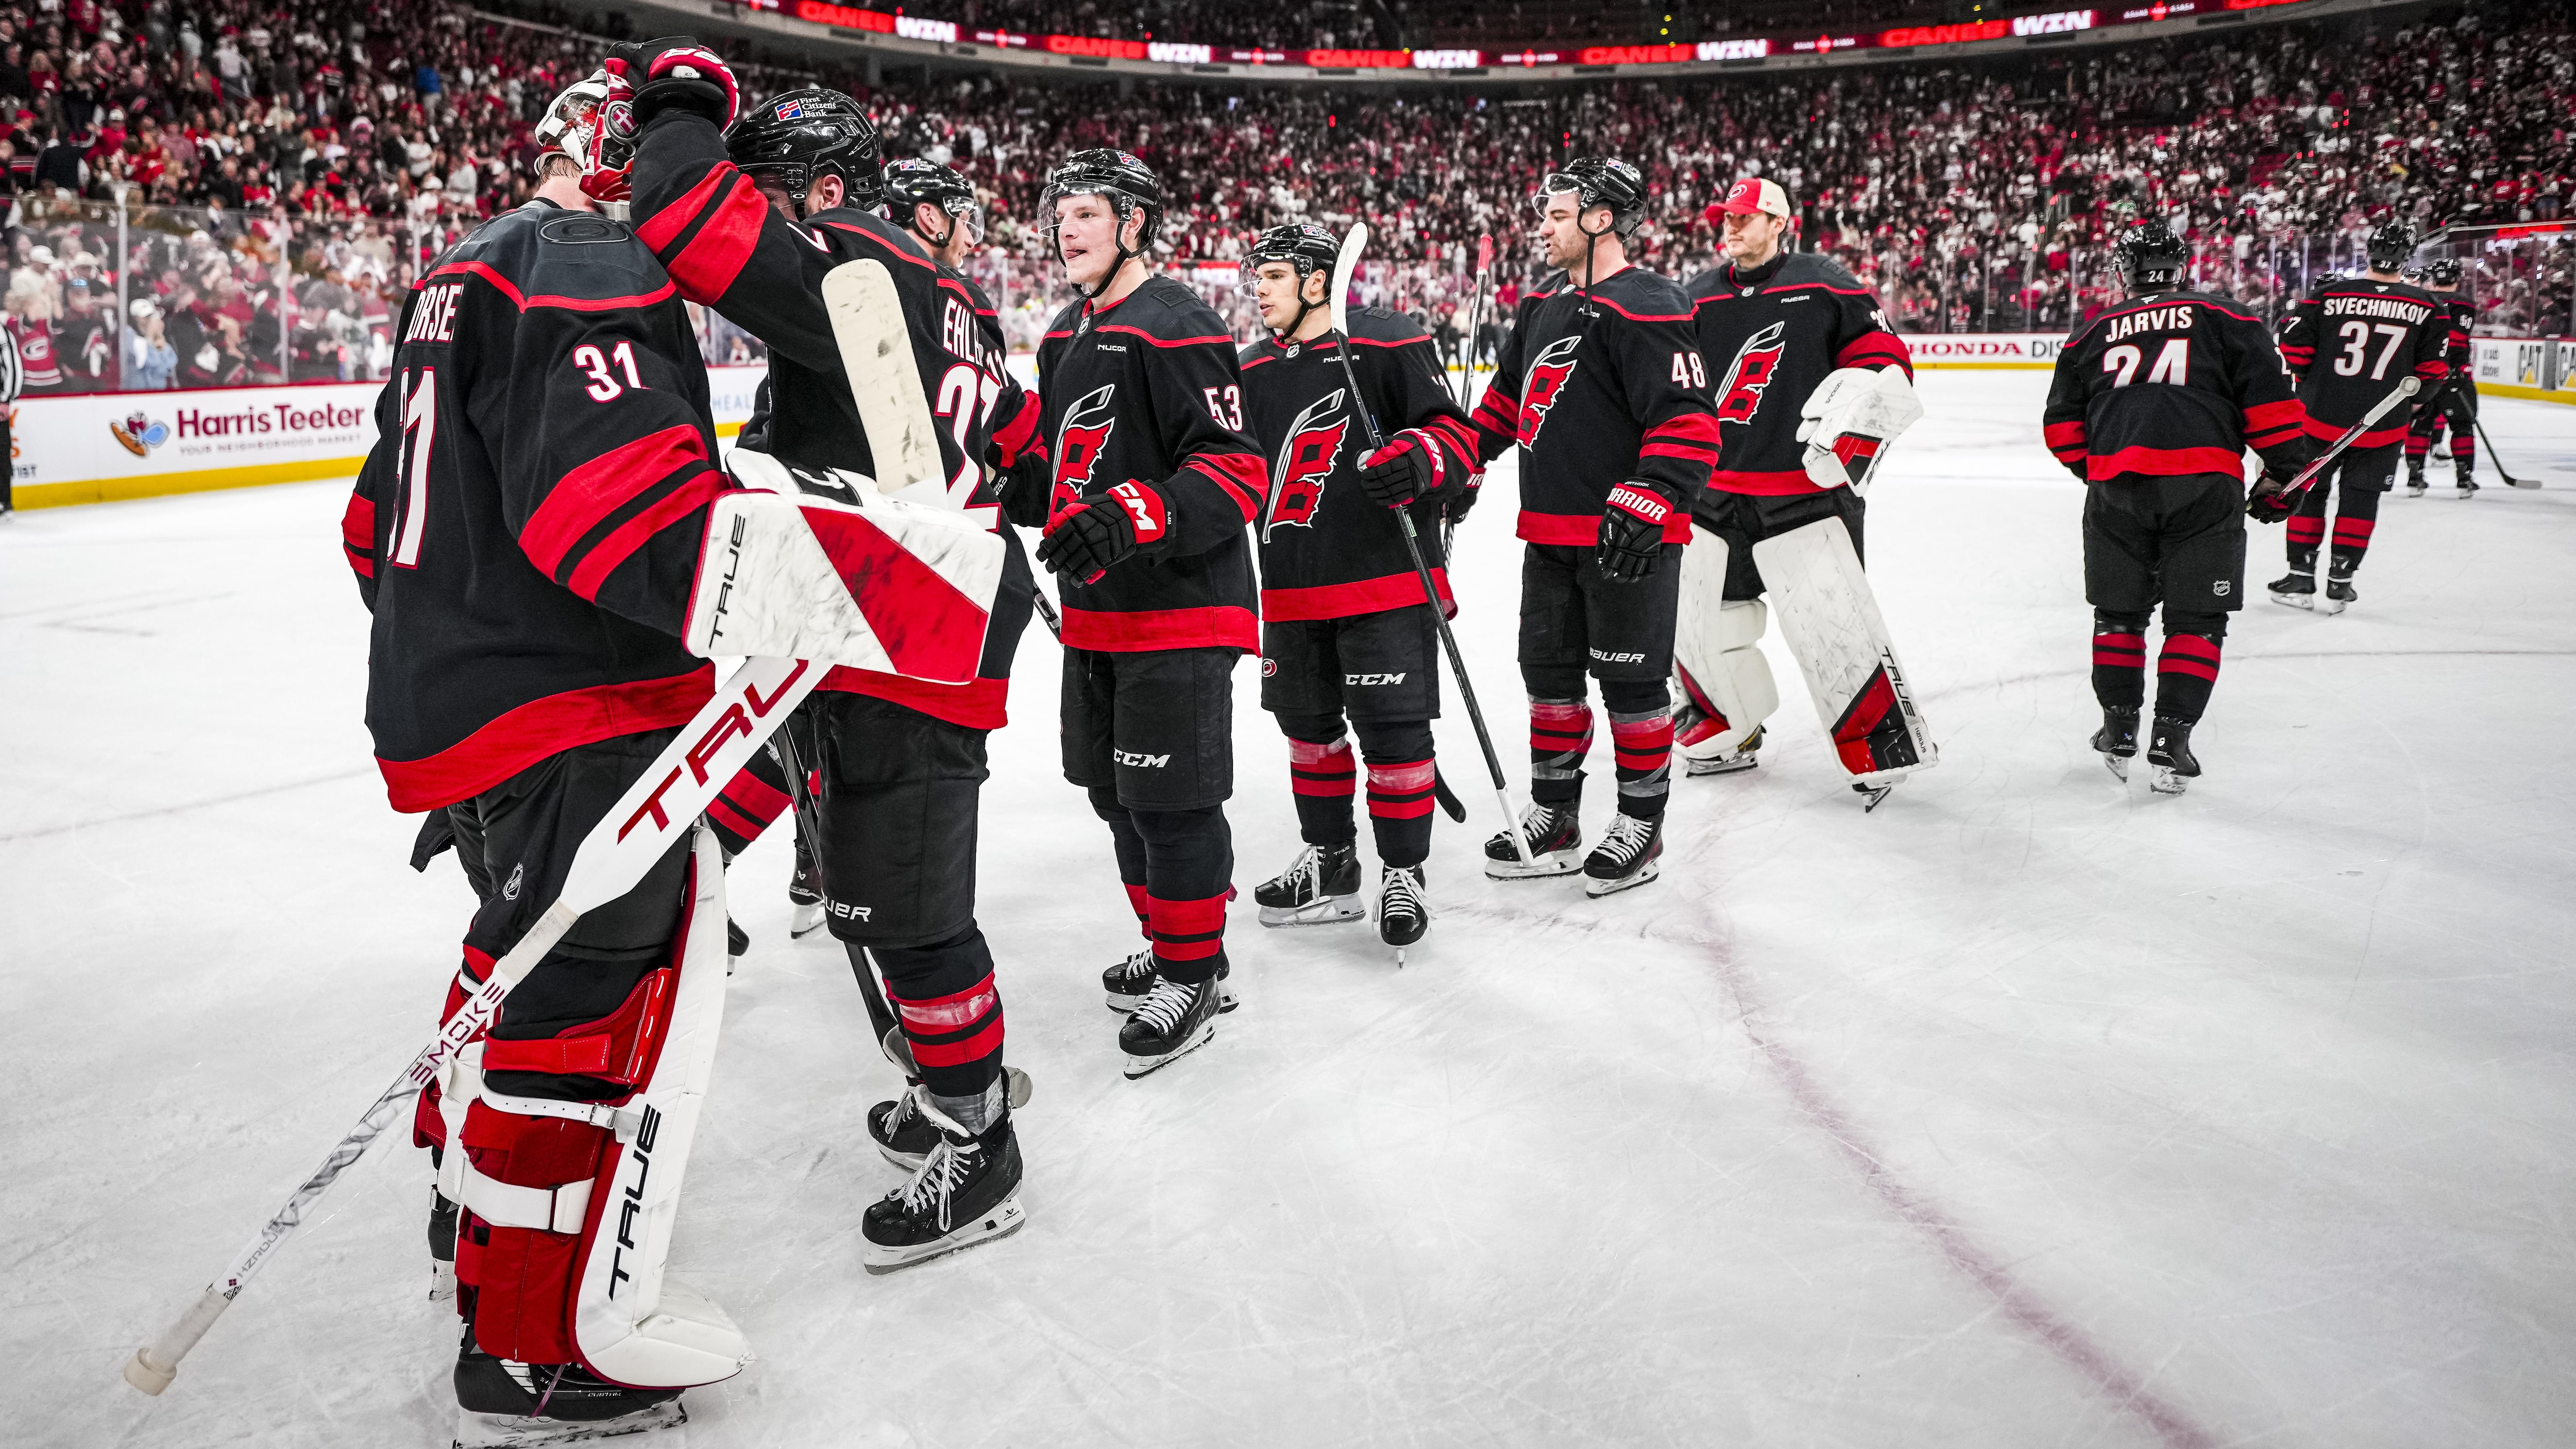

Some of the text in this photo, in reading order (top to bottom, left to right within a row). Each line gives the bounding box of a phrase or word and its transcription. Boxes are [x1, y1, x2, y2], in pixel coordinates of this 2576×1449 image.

[895, 16, 957, 43] WIN
[2012, 9, 2092, 37] WIN
[1148, 42, 1211, 63] WIN
[1413, 50, 1479, 70] WIN
[1697, 39, 1768, 61] WIN
[803, 110, 828, 118] Bank
[2148, 270, 2164, 283] 24
[2105, 305, 2193, 343] JARVIS
[2324, 297, 2432, 326] SVECHNIKOV
[1097, 344, 1127, 352] NUCOR
[1324, 354, 1360, 363] NUCR
[1907, 343, 2024, 355] HONDA
[2334, 320, 2409, 381] 37
[573, 340, 643, 403] 31
[986, 349, 1009, 390] 11
[1672, 351, 1706, 390] 48
[2103, 338, 2191, 388] 24
[711, 393, 755, 412] HEAL
[1204, 384, 1242, 432] 53
[177, 403, 366, 438] Harris Teeter
[180, 444, 212, 455] YOUR
[1867, 440, 1891, 485] TRUE
[1111, 482, 1158, 531] CM
[708, 513, 746, 650] TRUE
[1345, 672, 1406, 686] CCM
[1882, 645, 1916, 717] TRUE
[617, 658, 809, 846] TRU
[1114, 747, 1171, 768] CCM
[825, 895, 872, 923] UER
[410, 981, 505, 1085] SMOKE
[609, 1104, 662, 1302] TRUE
